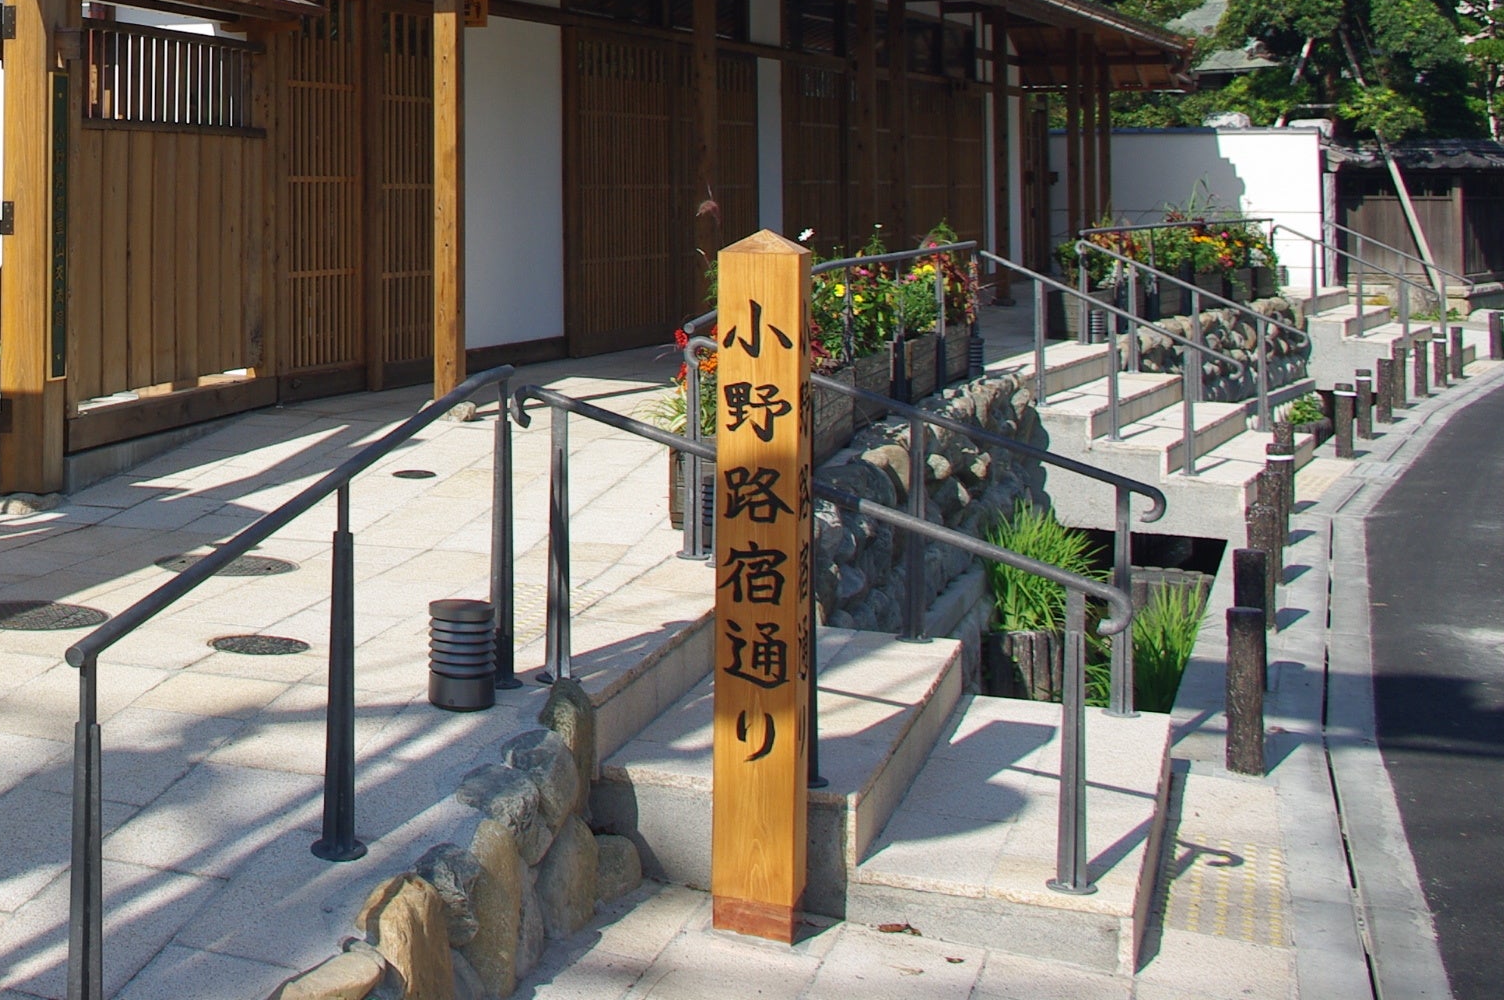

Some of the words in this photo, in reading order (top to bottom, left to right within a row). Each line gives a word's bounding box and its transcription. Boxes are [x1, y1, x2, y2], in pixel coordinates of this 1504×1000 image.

[719, 298, 795, 762] 小野路宿通り
